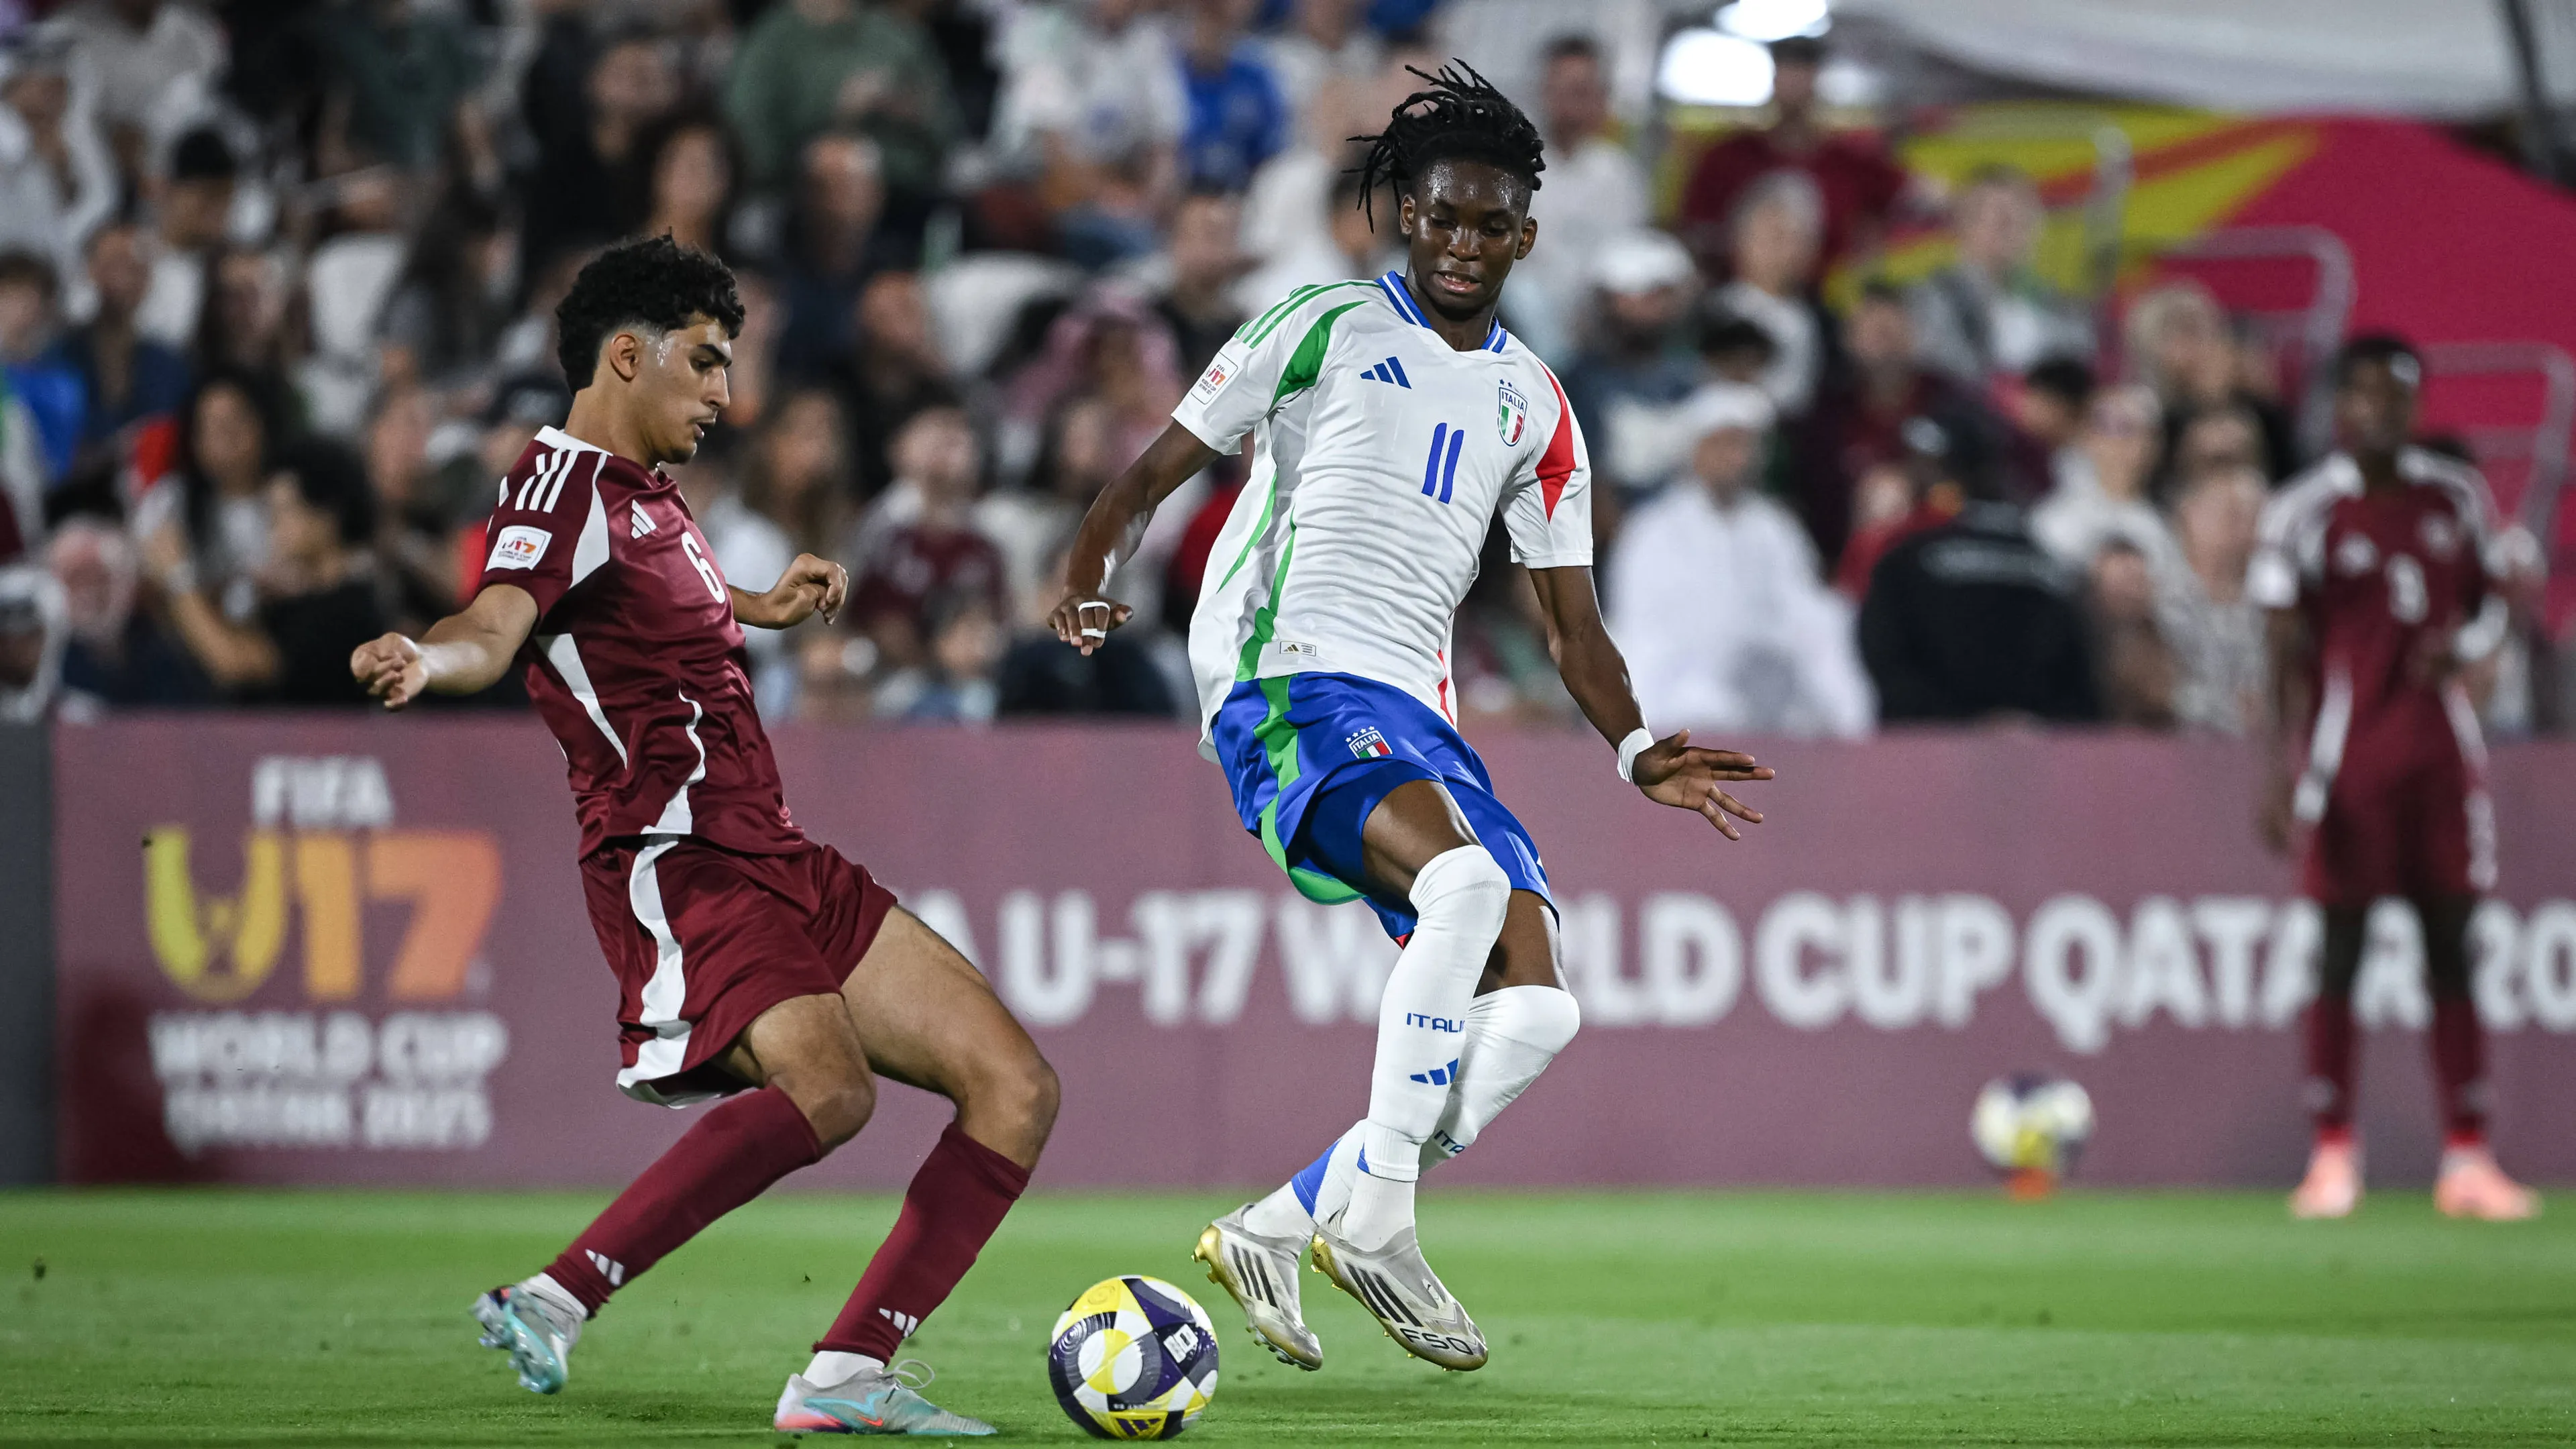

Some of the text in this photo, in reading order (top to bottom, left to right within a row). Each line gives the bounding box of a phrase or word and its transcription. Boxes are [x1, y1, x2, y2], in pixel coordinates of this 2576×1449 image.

[1501, 390, 1525, 413] ITALIA
[1421, 422, 1465, 505] 11
[681, 531, 726, 604] 6
[1352, 733, 1381, 752] ITALIA
[146, 829, 502, 997] U17
[1000, 892, 1265, 1025] U-17
[1756, 894, 2014, 1027] CUP
[1406, 1012, 1465, 1033] ITALI
[1399, 1328, 1474, 1355] F50
